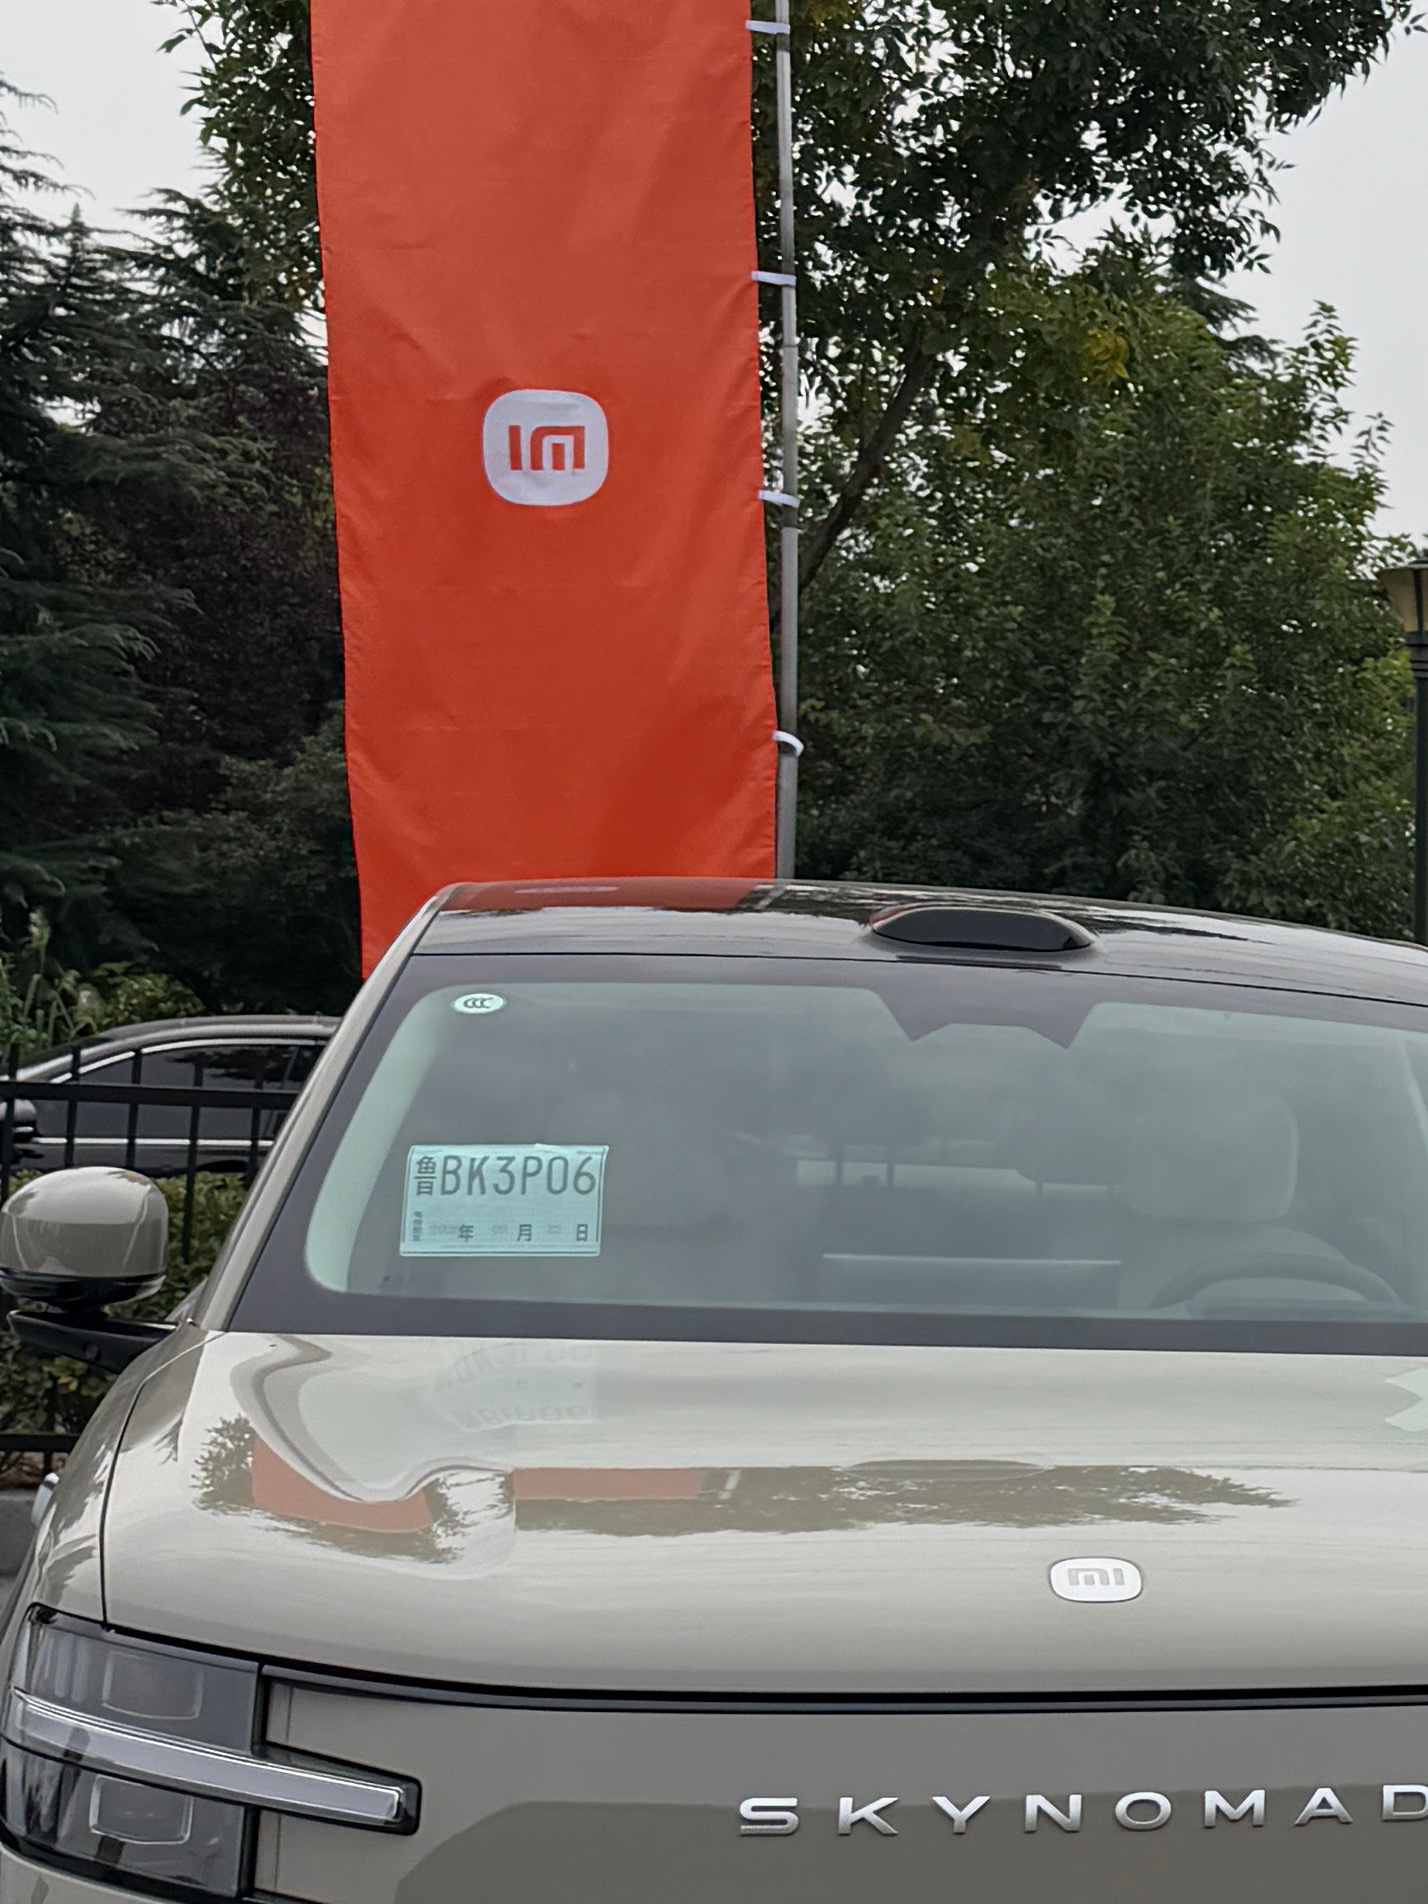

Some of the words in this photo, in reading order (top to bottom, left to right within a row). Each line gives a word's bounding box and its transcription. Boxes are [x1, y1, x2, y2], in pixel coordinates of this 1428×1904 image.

[415, 1155, 597, 1197] 鲁BK3P06
[517, 1223, 533, 1242] 月
[576, 1223, 589, 1242] 日
